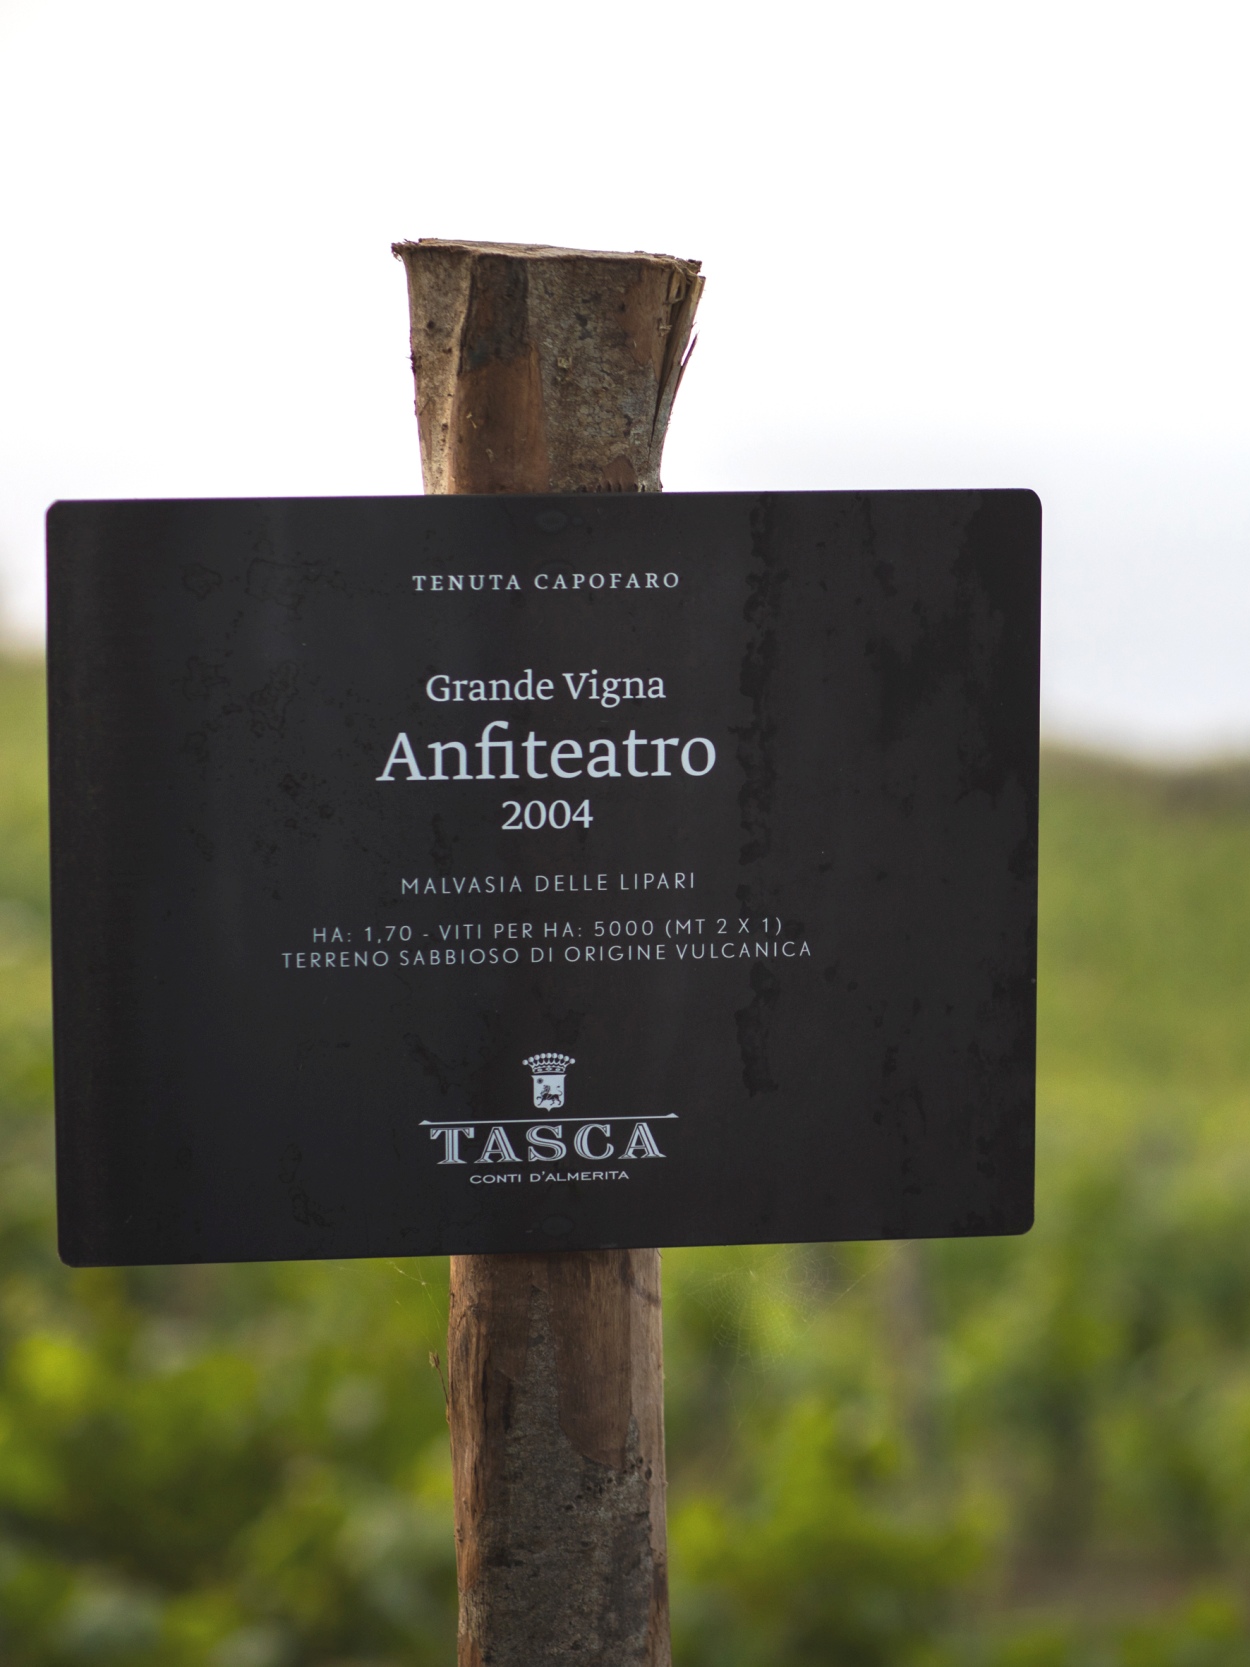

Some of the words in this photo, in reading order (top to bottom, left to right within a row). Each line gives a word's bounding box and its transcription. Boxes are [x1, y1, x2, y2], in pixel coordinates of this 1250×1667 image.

[412, 574, 521, 591] TENUTA
[534, 572, 679, 590] CAPOFARO
[425, 668, 555, 702] Grande
[561, 668, 667, 709] Vigna
[375, 720, 717, 782] Anfiteatro
[501, 799, 594, 830] 2004
[401, 875, 522, 895] MALVASIA
[535, 873, 608, 892] DELLE
[620, 872, 694, 891] LIPARI
[313, 926, 351, 943] HA:
[364, 925, 412, 944] 1,70
[438, 923, 481, 941] VITI
[494, 922, 533, 939] PER
[544, 921, 583, 938] HA:
[594, 919, 654, 937] 5000
[665, 918, 706, 939] (MT
[716, 918, 728, 934] 2
[738, 918, 750, 934] X
[762, 916, 782, 936] 1)
[281, 950, 389, 969] TERRENO
[399, 947, 519, 966] SABBIOSO
[531, 946, 553, 963] DI
[564, 944, 666, 963] ORIGINE
[675, 941, 811, 960] VULCANICA
[429, 1121, 667, 1165] TASCA
[469, 1173, 522, 1185] CONTI
[529, 1170, 630, 1183] D'ALMERITA
